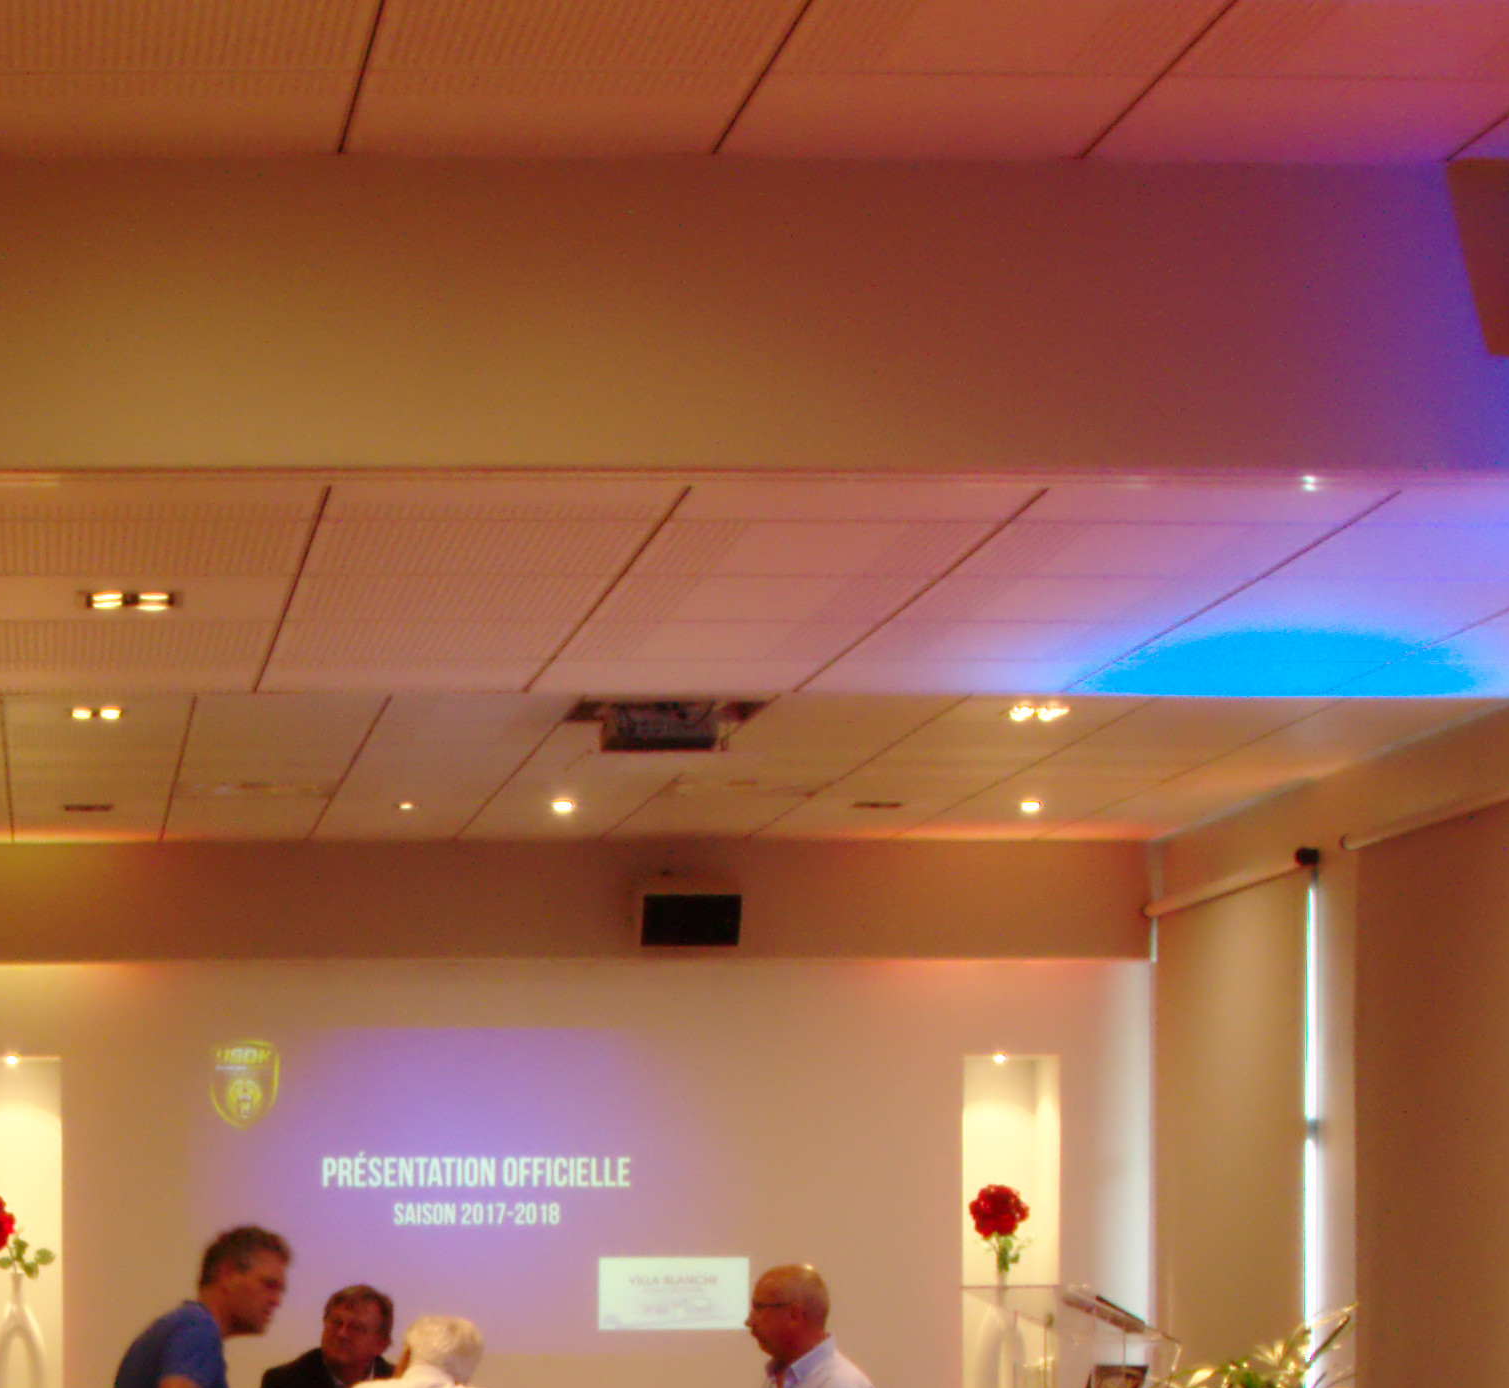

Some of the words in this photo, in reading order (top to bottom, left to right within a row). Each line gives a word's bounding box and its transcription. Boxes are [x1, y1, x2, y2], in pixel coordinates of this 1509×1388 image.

[322, 1151, 496, 1187] PRÉSENTATION
[503, 1157, 631, 1187] OFFICIELLE
[393, 1203, 456, 1225] SAISON
[461, 1203, 561, 1225] 2017-2018
